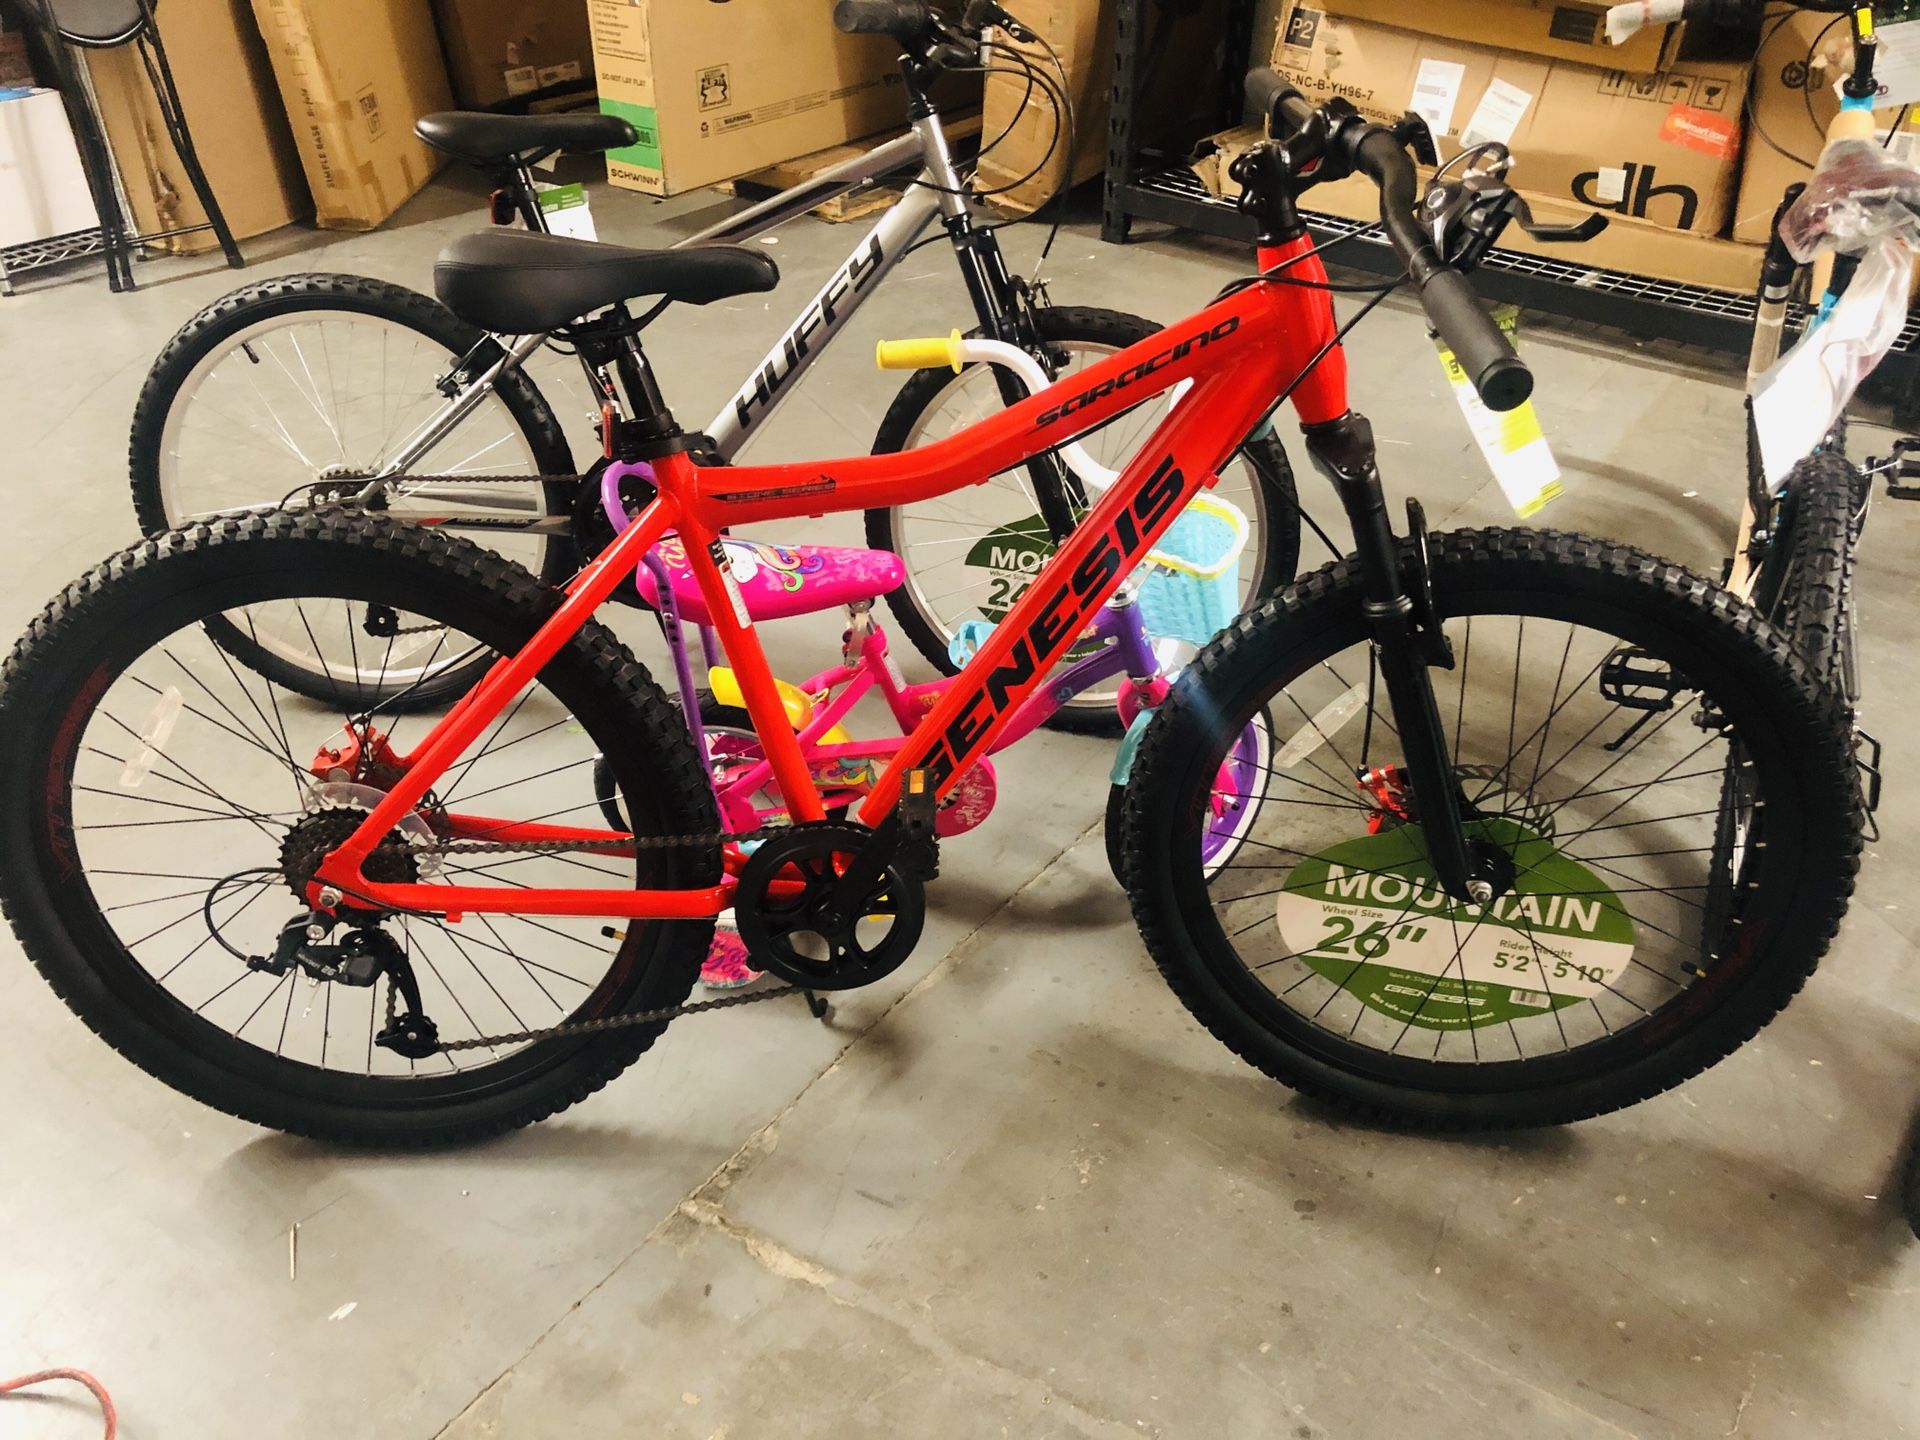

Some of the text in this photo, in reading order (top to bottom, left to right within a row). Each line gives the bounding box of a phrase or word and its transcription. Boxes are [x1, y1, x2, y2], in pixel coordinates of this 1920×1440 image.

[1289, 17, 1314, 40] P2
[310, 124, 326, 151] BASE
[317, 153, 335, 189] SIMPLE
[610, 167, 658, 186] SCHWINN
[735, 233, 883, 429] HUFFY
[1322, 904, 1384, 919] Wheel Size
[1499, 939, 1531, 952] Rider
[1383, 984, 1488, 1007] GENESIS
